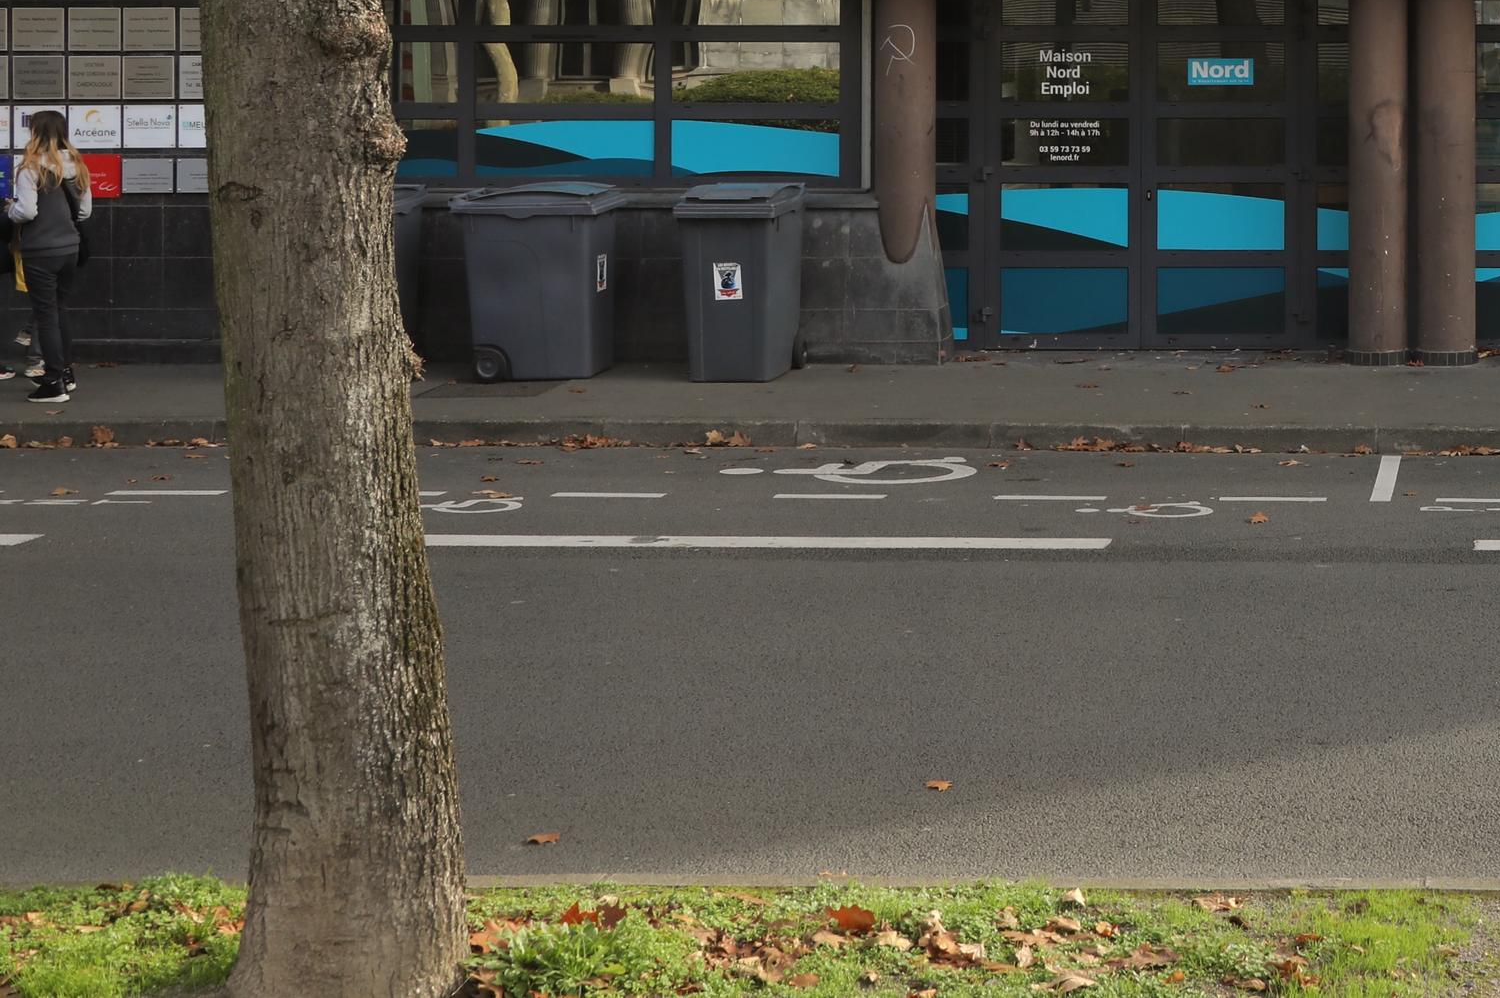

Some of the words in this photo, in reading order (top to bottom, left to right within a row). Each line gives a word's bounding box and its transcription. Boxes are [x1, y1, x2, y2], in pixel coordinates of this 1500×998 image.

[1040, 48, 1091, 62] Maison
[1046, 64, 1080, 78] Nord
[1192, 60, 1249, 78] Nord
[1041, 81, 1090, 97] Emploi
[1041, 120, 1059, 128] lundi
[1070, 120, 1100, 128] vendredi
